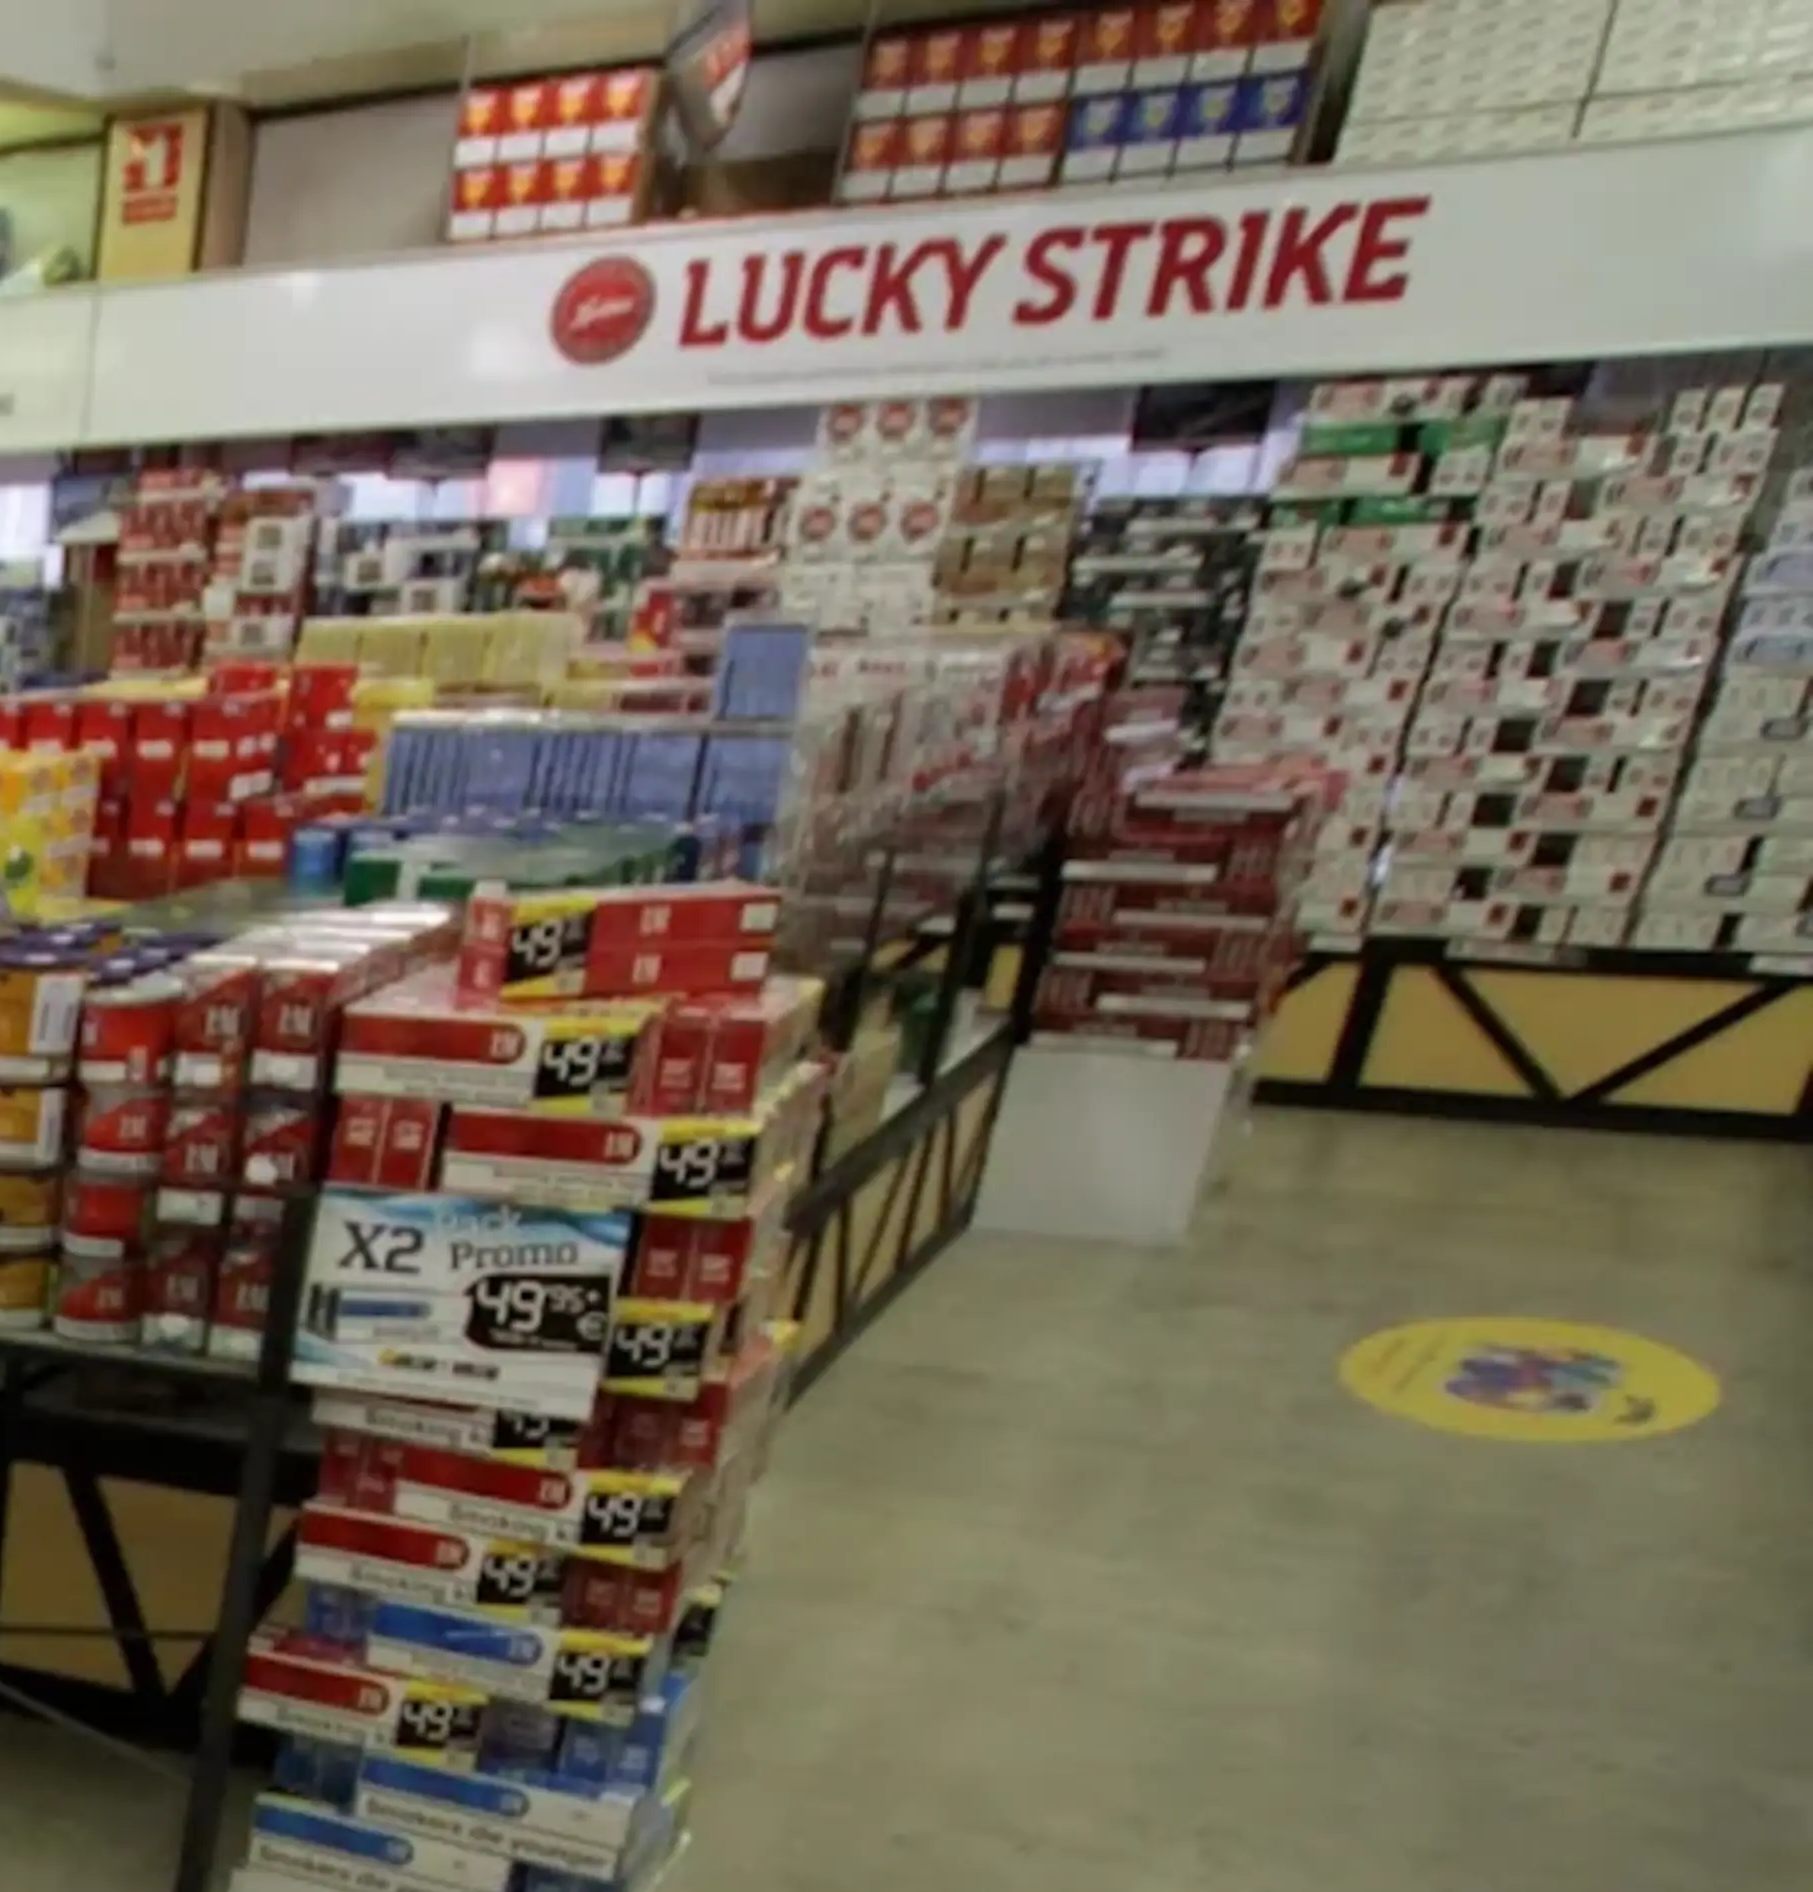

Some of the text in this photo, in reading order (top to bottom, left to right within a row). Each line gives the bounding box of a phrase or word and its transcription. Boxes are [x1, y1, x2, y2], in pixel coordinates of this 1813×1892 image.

[679, 195, 1432, 349] LUCKY STRIKE
[543, 1036, 600, 1086] 49
[660, 1139, 719, 1188] 49
[338, 1220, 424, 1273] X2
[449, 1239, 579, 1270] Promo
